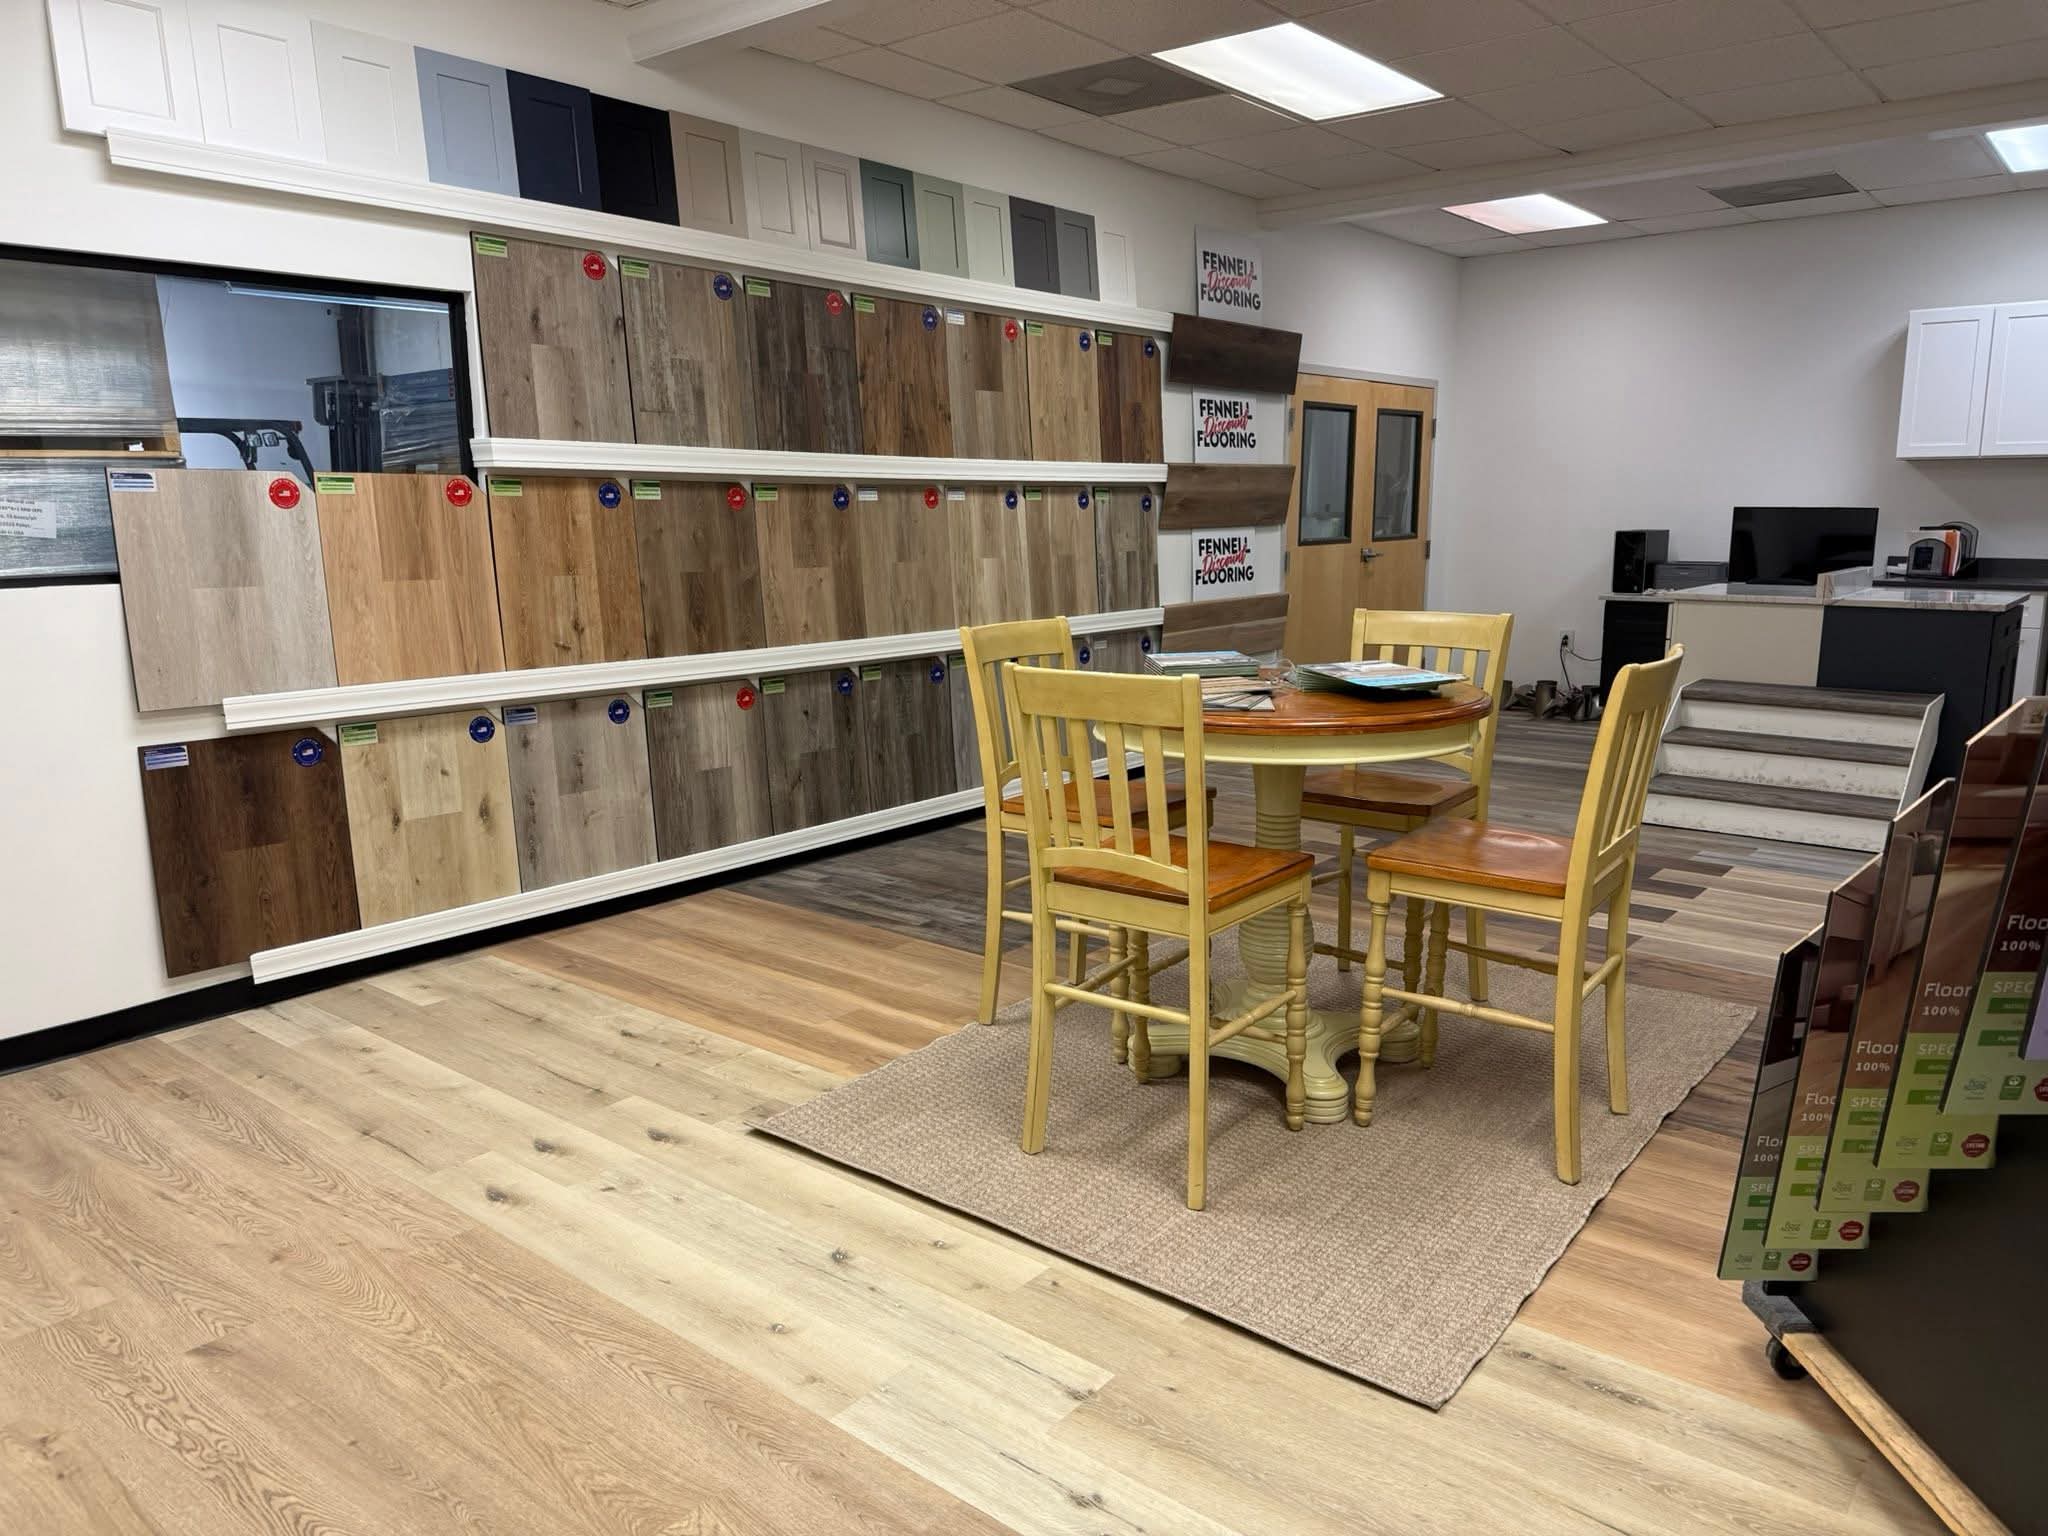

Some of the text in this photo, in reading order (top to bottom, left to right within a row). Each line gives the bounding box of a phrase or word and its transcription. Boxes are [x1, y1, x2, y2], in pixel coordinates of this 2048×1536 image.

[1207, 264, 1254, 290] Discount
[1200, 283, 1261, 310] FLOORING
[1199, 398, 1253, 420] FENNELL
[1204, 408, 1249, 437] Discount
[1197, 430, 1256, 449] FLOORING
[1198, 536, 1251, 557] FENNELL
[1203, 545, 1248, 576] Discount
[1195, 565, 1255, 586] FLOORING
[2000, 940, 2041, 951] 100%
[1924, 982, 1973, 998] Floor
[1922, 1006, 1961, 1016] 100%
[1855, 1062, 1891, 1072] 100%
